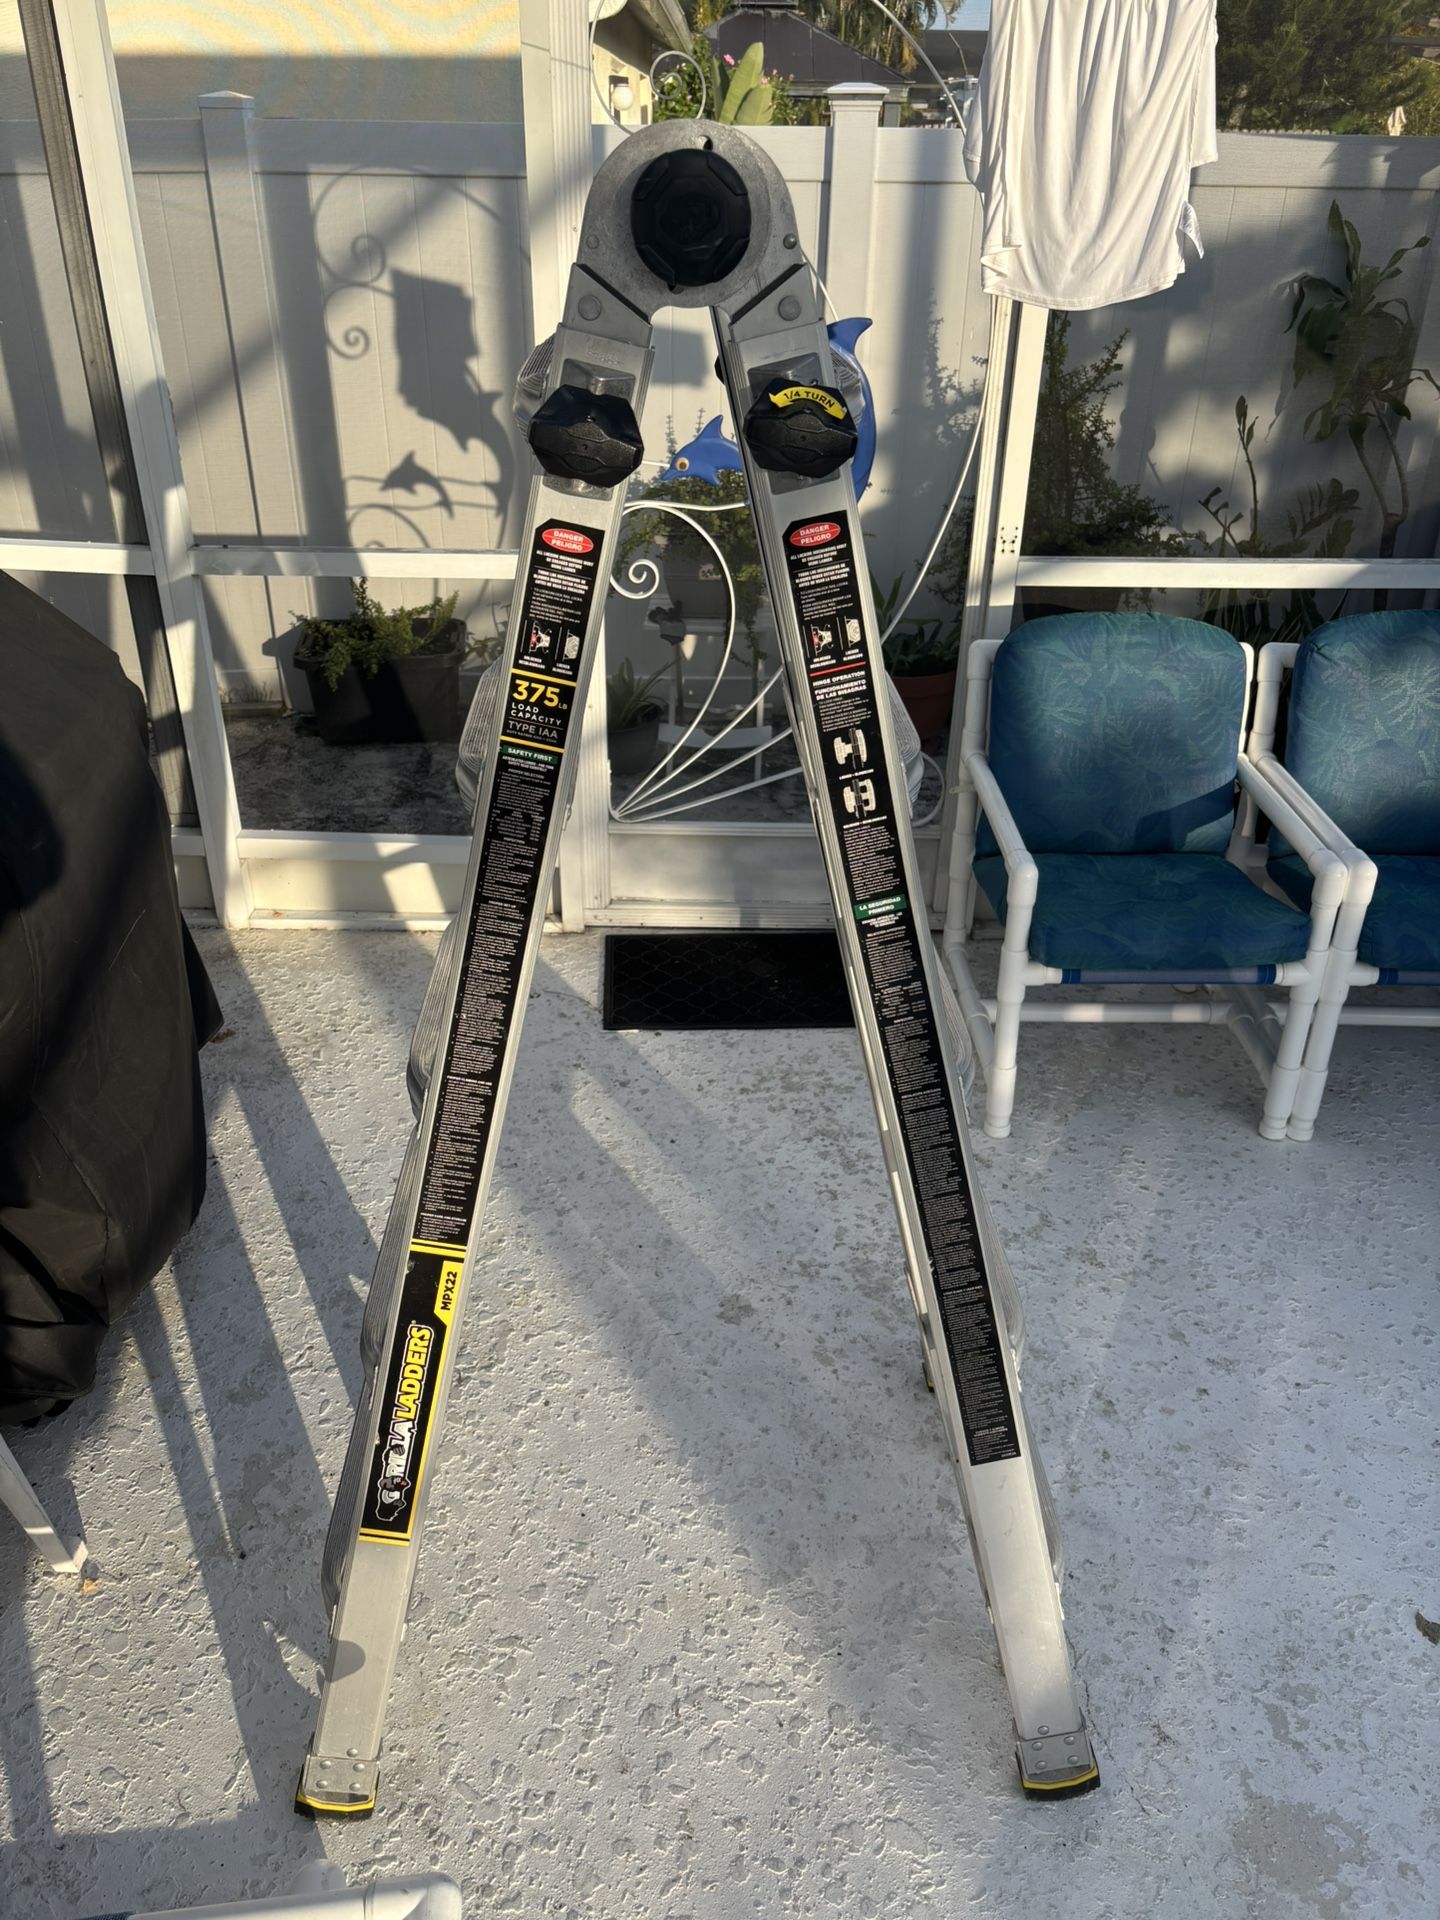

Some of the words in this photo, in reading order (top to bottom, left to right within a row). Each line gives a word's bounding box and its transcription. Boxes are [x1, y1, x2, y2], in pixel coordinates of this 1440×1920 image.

[784, 390, 801, 400] 1/4
[804, 391, 835, 408] TURN
[553, 530, 584, 543] DANGER
[800, 524, 830, 536] DANGER
[551, 539, 583, 552] PELIGRO
[800, 533, 832, 544] PELIGRO
[812, 678, 831, 687] HINGE
[832, 670, 866, 682] OPERATION
[512, 679, 560, 707] 375
[814, 680, 866, 695] FUNCIONAMIENTO
[512, 702, 539, 714] LOAD
[510, 710, 562, 726] CAPACITY
[508, 720, 536, 734] TYPE
[538, 727, 558, 739] IAA
[508, 747, 533, 758] SAFETY
[534, 753, 553, 762] FIRST
[868, 896, 901, 908] SEGURIDAD
[868, 904, 895, 914] PRIMERO
[440, 1271, 458, 1310] MPX22
[396, 1327, 432, 1420] LADDERS
[382, 1420, 414, 1504] GRILLA
